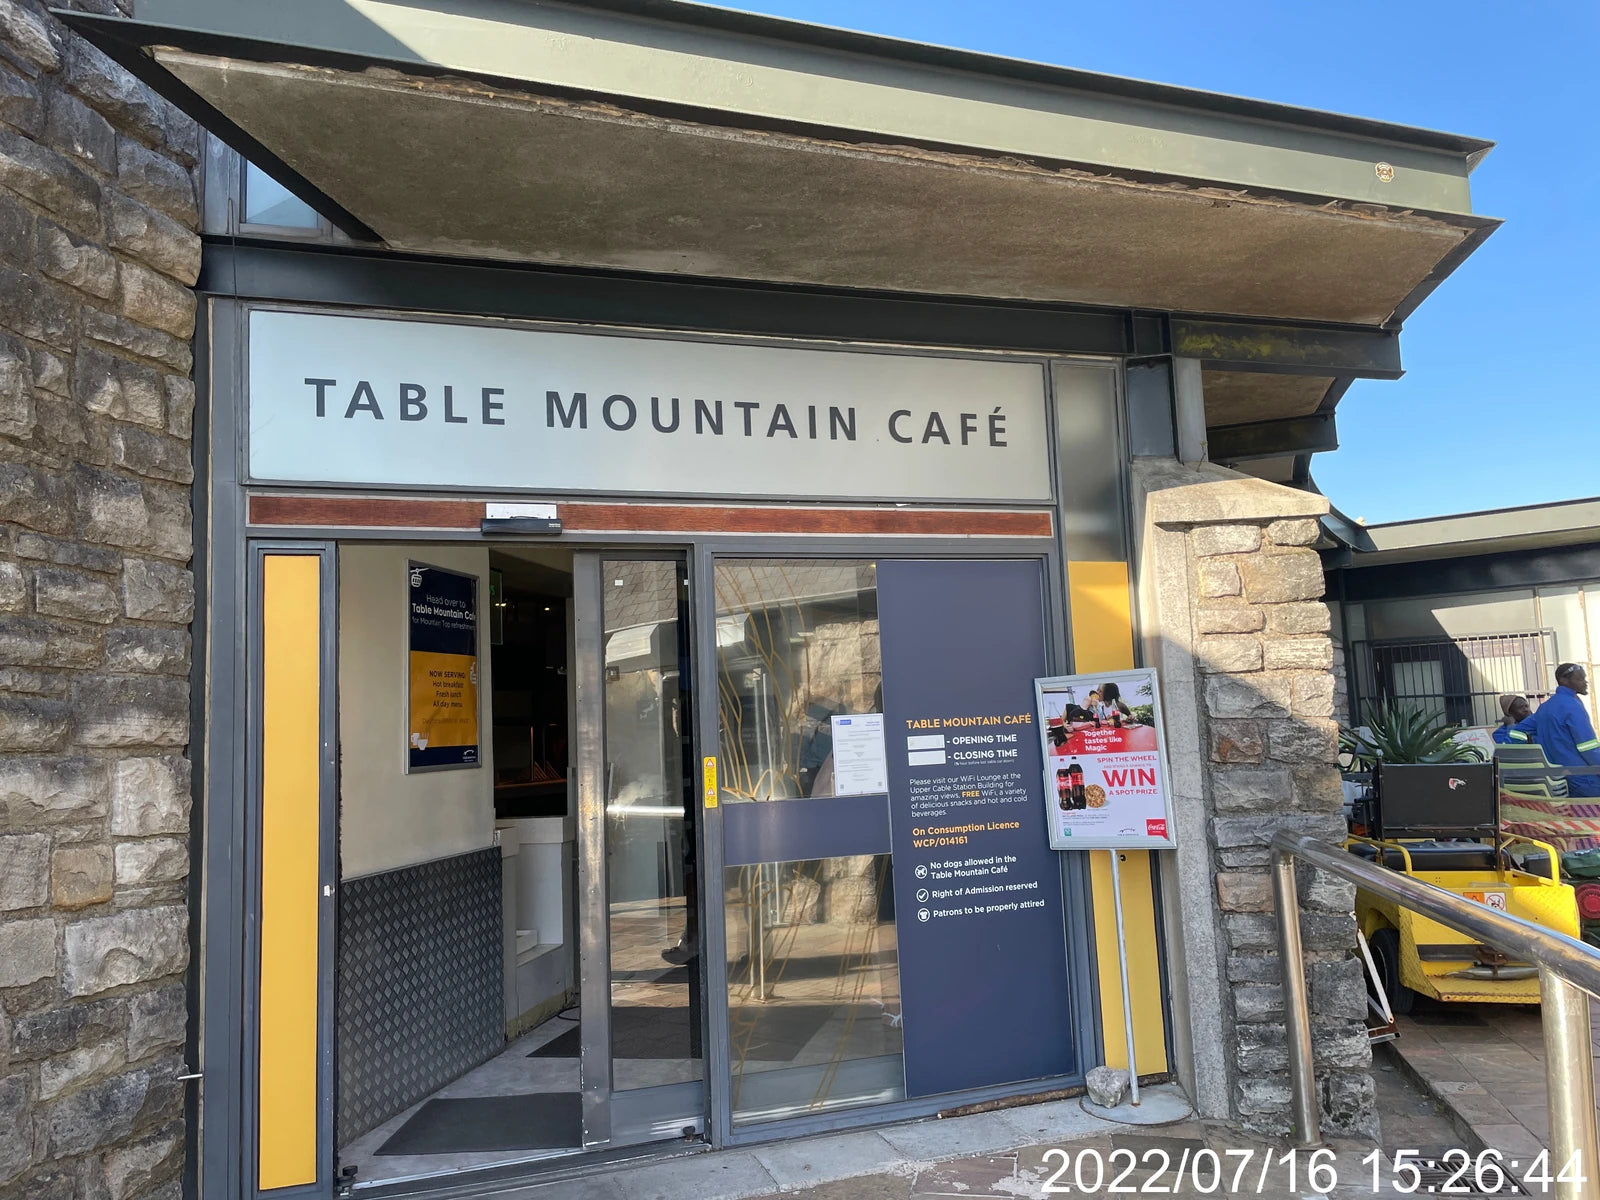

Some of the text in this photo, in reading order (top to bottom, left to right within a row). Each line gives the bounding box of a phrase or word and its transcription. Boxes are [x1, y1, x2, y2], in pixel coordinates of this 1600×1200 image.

[304, 378, 1007, 447] TABLE MOUNTAIN CAFÉ
[426, 594, 466, 608] Head over to
[412, 602, 432, 614] Table
[433, 606, 463, 619] Mountain
[429, 670, 443, 678] NOW
[442, 681, 464, 689] breakfast
[436, 690, 449, 698] Fresh
[440, 701, 450, 709] day
[906, 713, 1032, 729] TABLE MOUNTAIN CAFÉ
[952, 735, 994, 745] OPENING
[996, 734, 1018, 743] TIME
[1084, 729, 1116, 738] Together
[953, 750, 995, 760] CLOSING
[996, 749, 1018, 758] TIME
[976, 774, 1001, 783] Lounge
[1102, 768, 1156, 787] WIN
[909, 780, 1015, 794] Upper Cable Station Building for
[910, 793, 939, 802] amazing
[961, 790, 980, 798] FREE
[1004, 787, 1027, 796] variety
[919, 800, 949, 809] delicious
[950, 799, 973, 807] snacks
[911, 810, 947, 818] beverages.
[912, 821, 1020, 836] On Consumption Licence
[913, 835, 968, 848] WCP/014161
[930, 855, 1017, 869] No dogs allowed in the
[931, 865, 1008, 879] Table Mountain Café
[932, 880, 1038, 899] Right of Admission reserved
[933, 907, 963, 918] Patrons
[974, 905, 985, 913] be
[986, 902, 1018, 914] properly
[1019, 898, 1045, 909] attired
